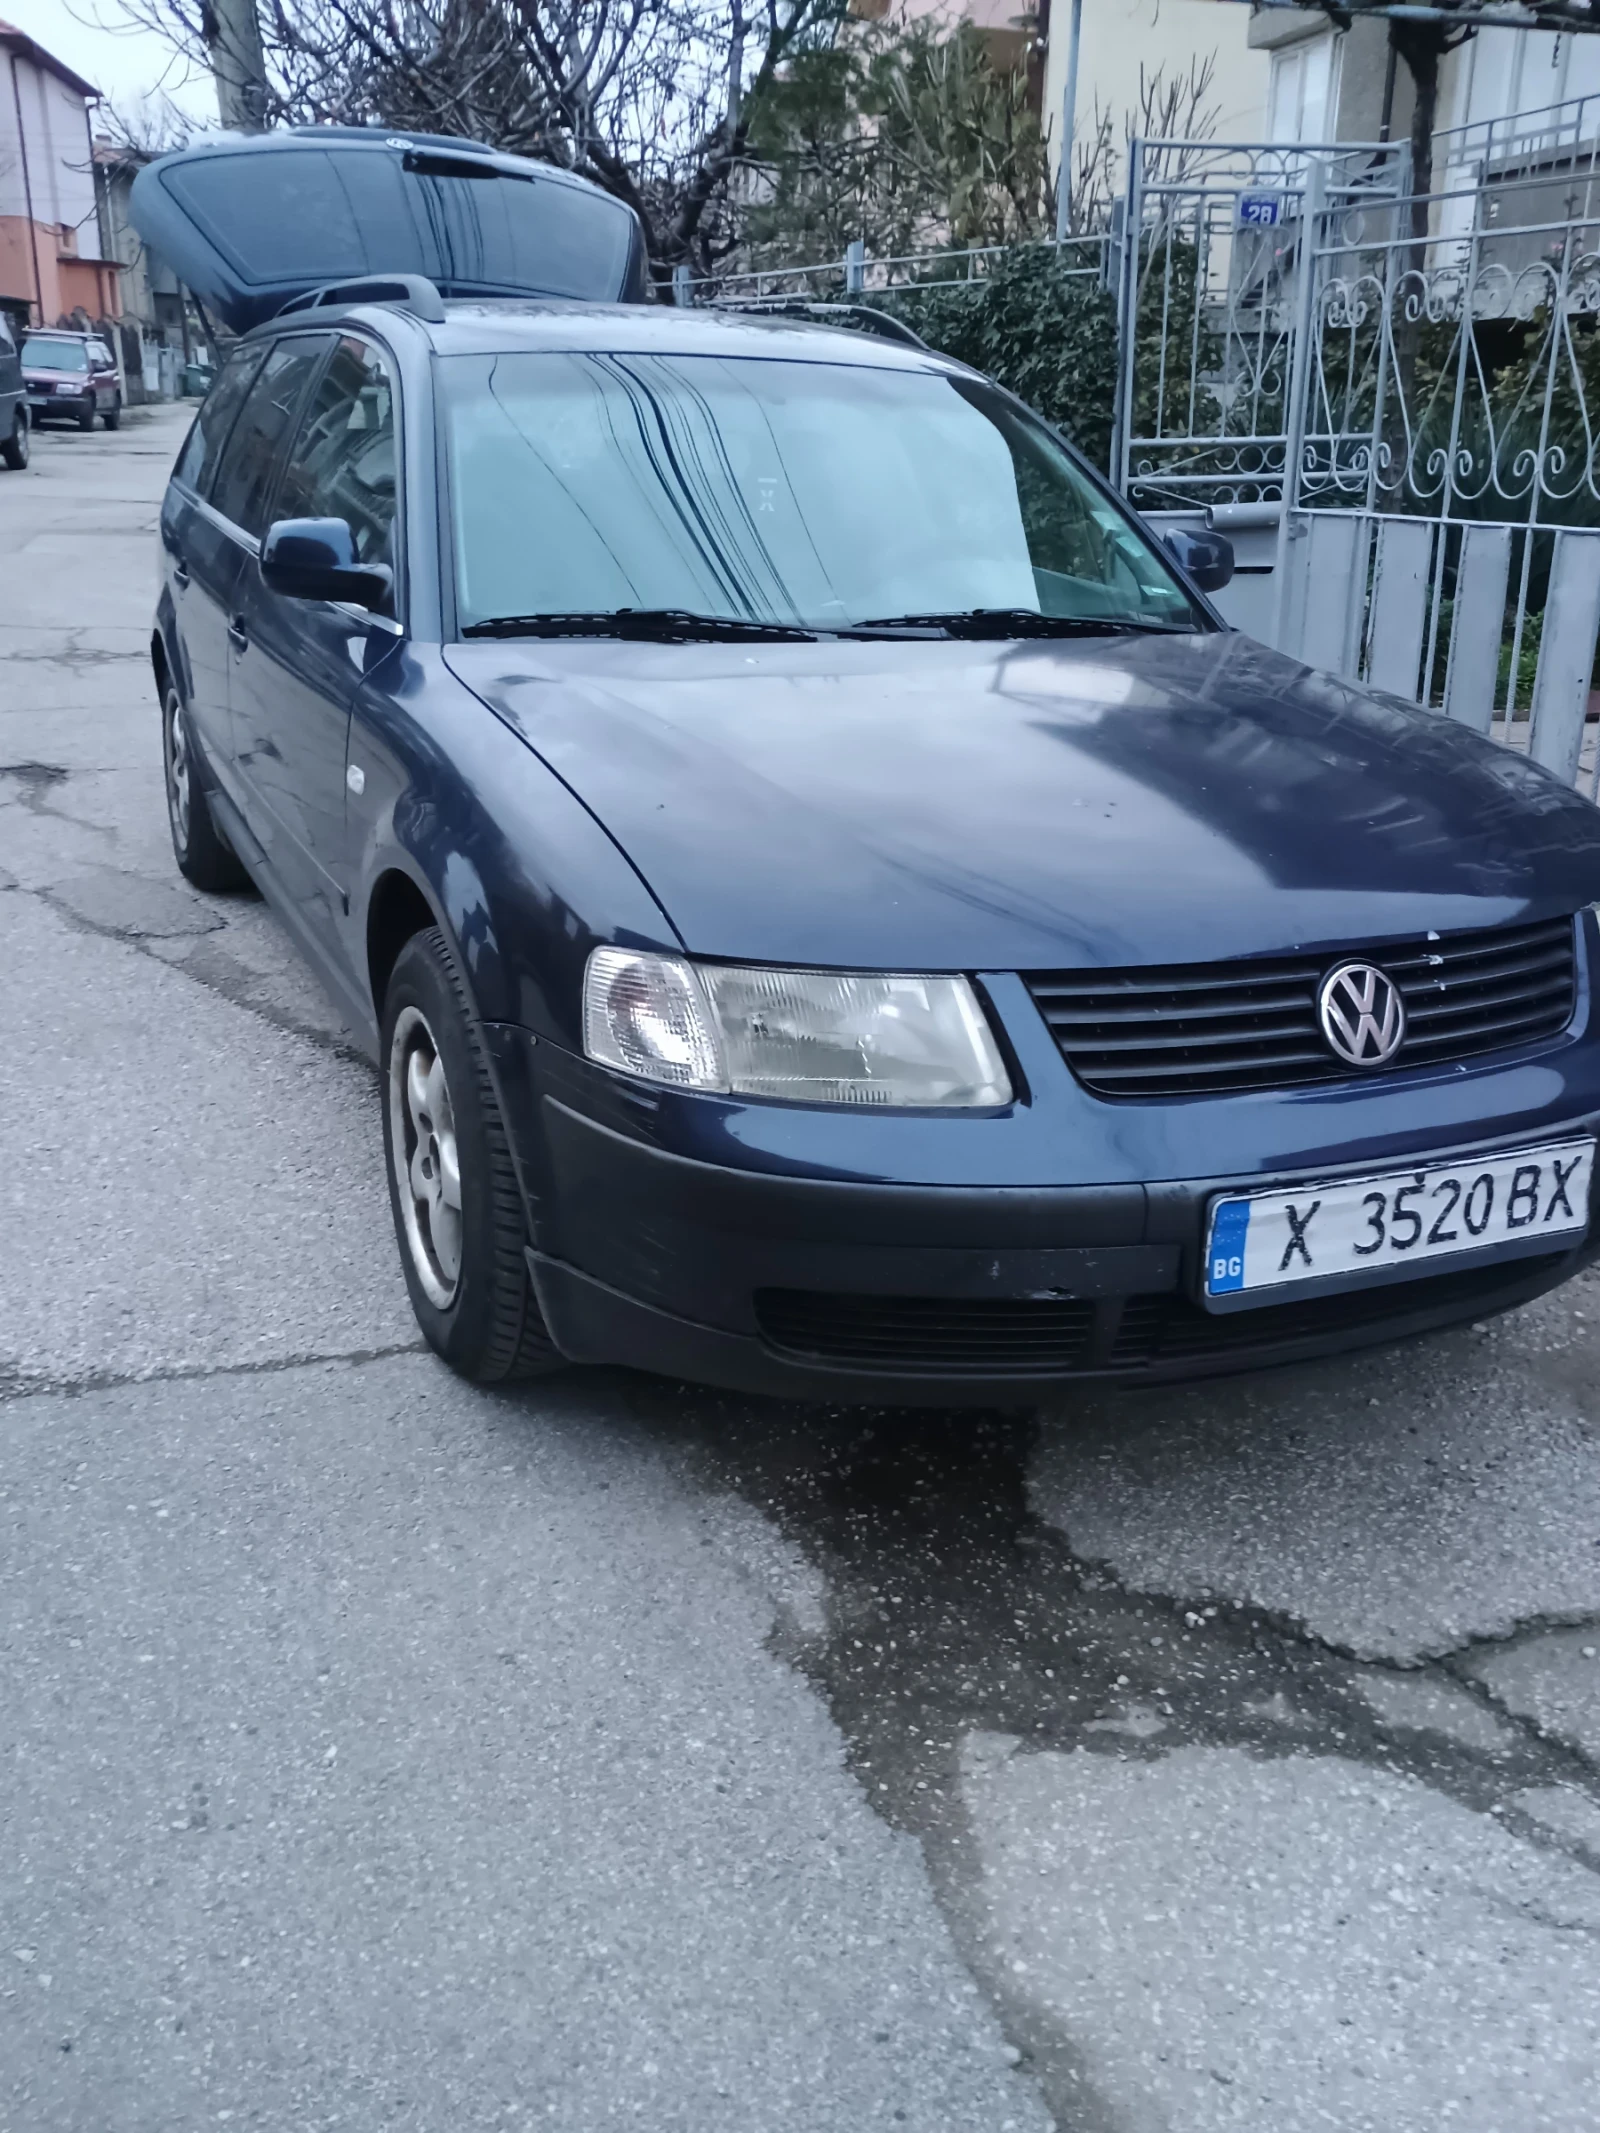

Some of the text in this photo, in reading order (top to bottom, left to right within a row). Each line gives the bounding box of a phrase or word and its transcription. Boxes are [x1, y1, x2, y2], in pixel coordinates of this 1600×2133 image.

[1248, 205, 1272, 225] 28
[1321, 964, 1404, 1066] VW
[1278, 1155, 1582, 1271] X 3520 BX
[1213, 1256, 1241, 1280] BG
